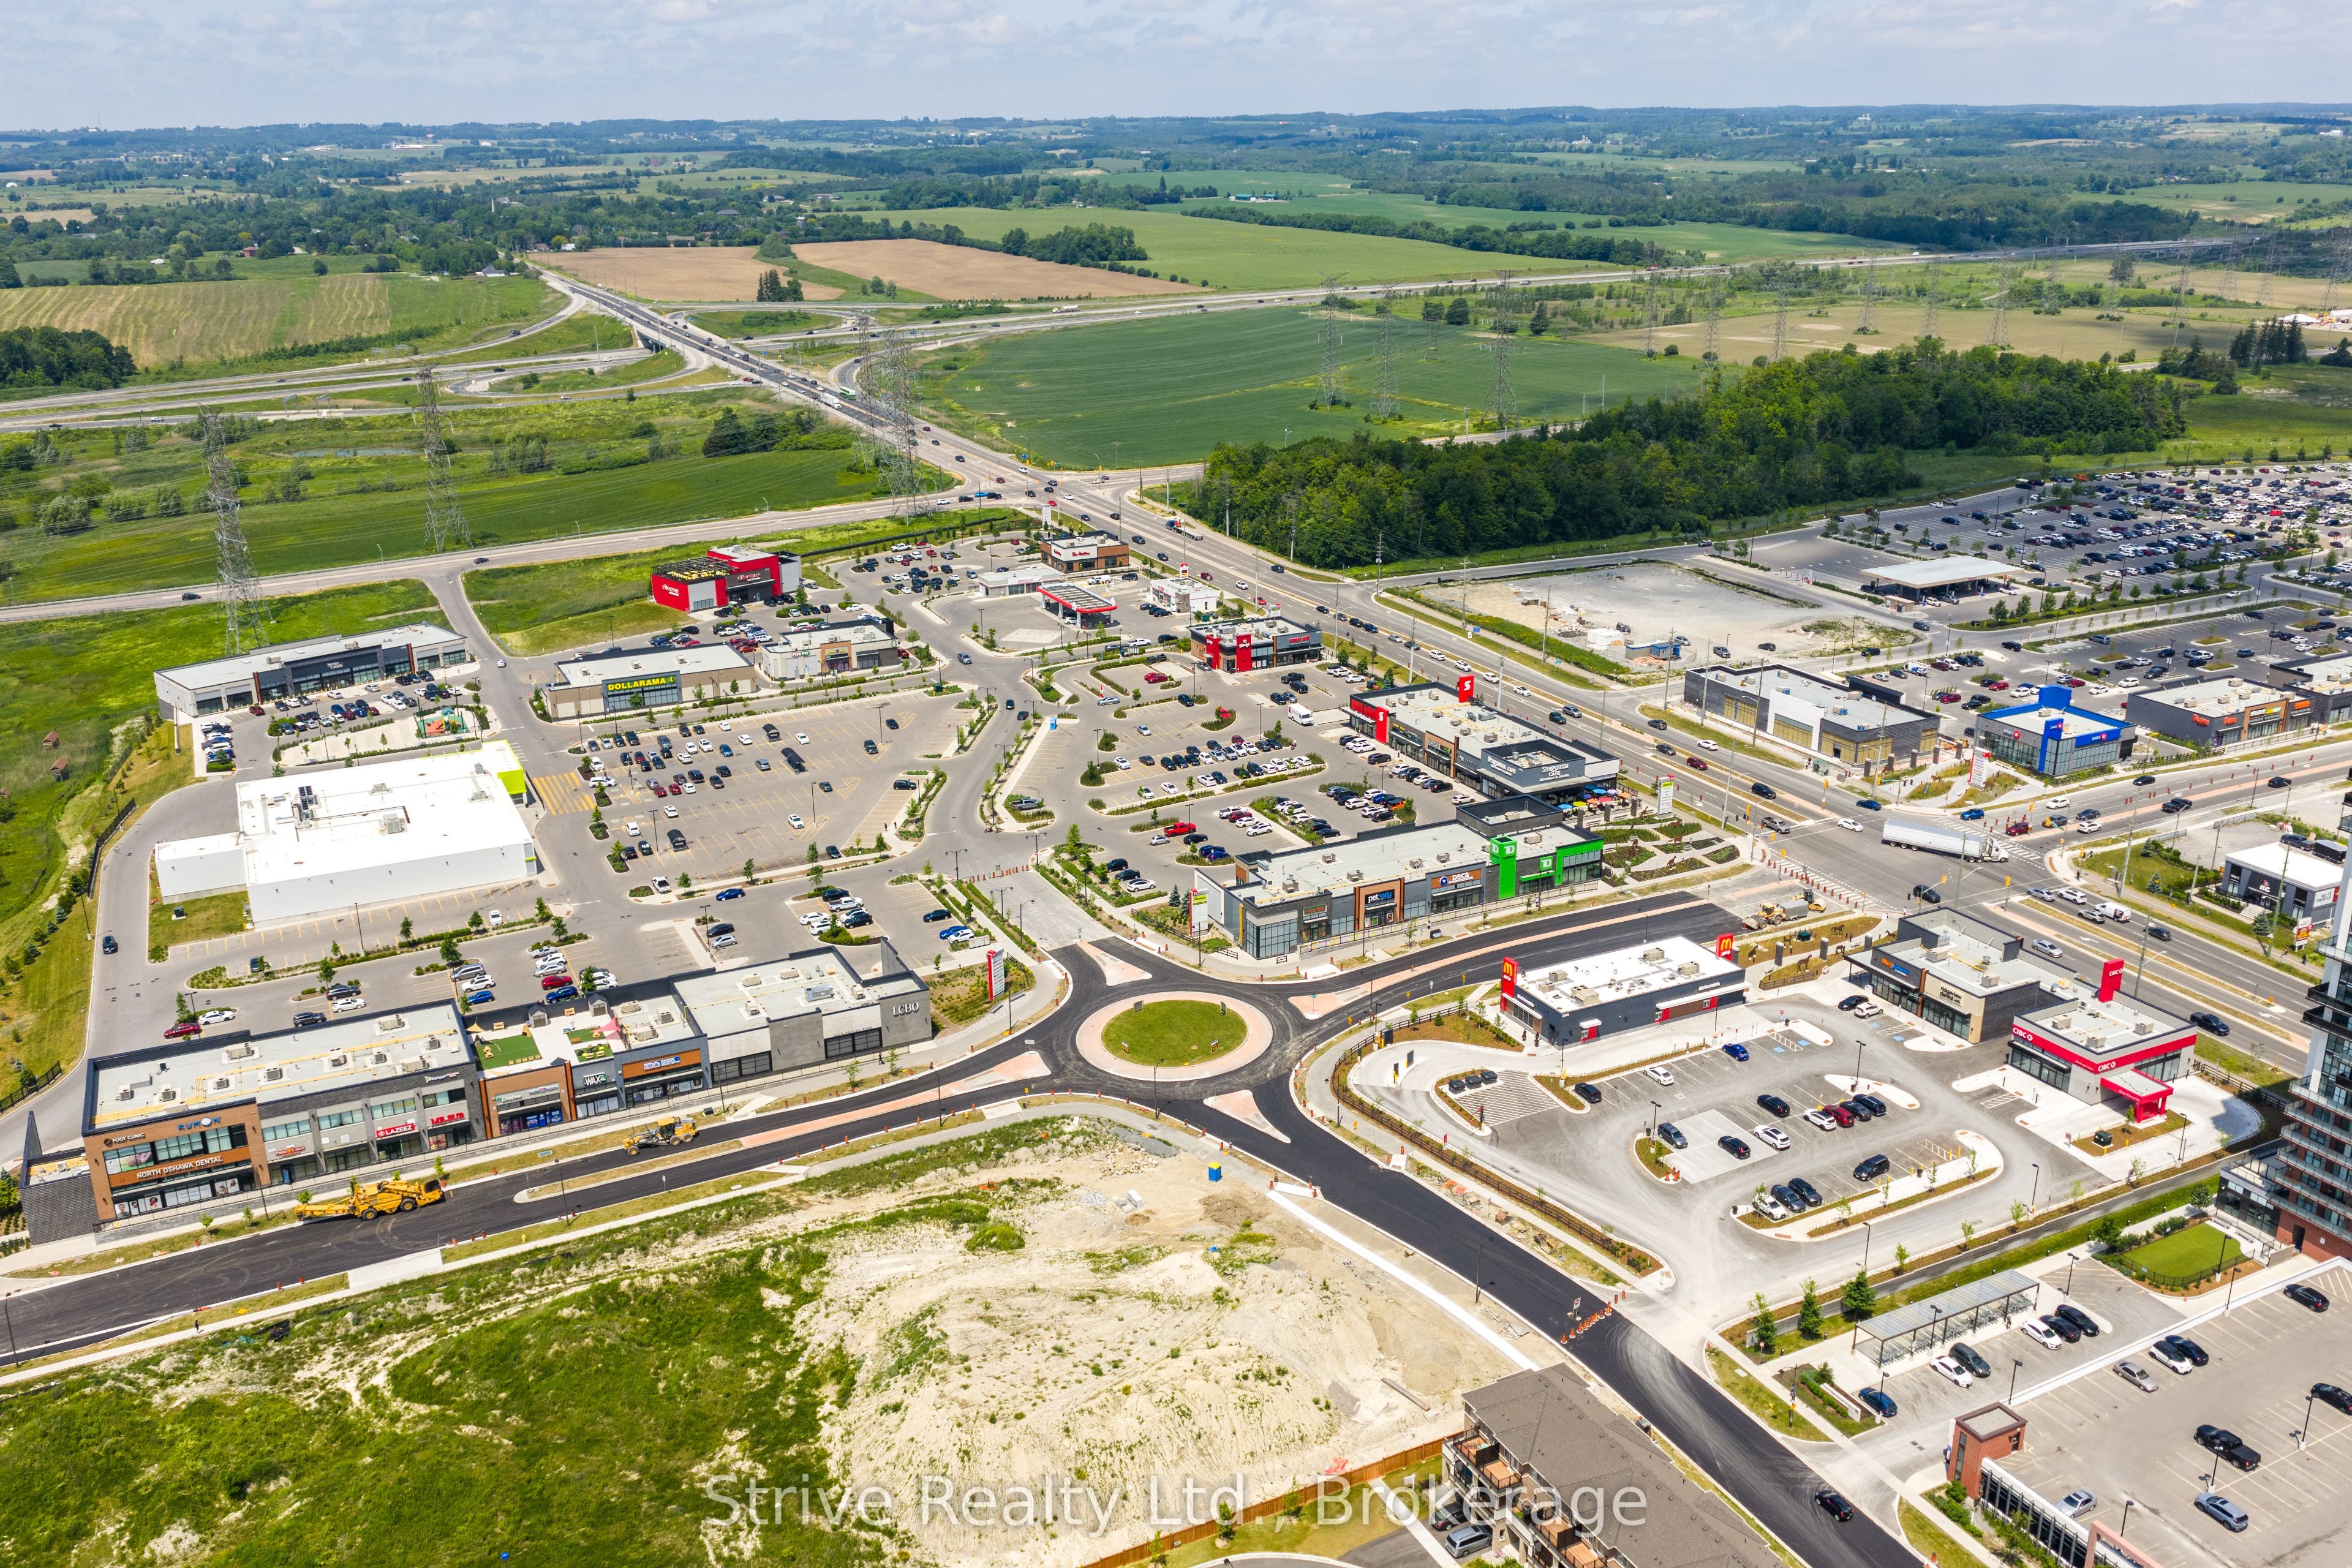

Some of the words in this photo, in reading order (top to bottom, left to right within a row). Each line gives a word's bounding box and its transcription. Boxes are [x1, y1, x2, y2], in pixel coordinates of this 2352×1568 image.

[608, 677, 666, 691] DOLLARAMA
[1491, 842, 1499, 854] TD
[1504, 845, 1515, 854] TD
[1541, 859, 1551, 868] TD
[1368, 894, 1379, 903] pet
[1379, 891, 1392, 900] valu
[1940, 986, 1962, 999] ridgeview
[892, 1001, 919, 1016] LCBO
[2013, 1027, 2027, 1039] CIBC
[2098, 1063, 2111, 1072] CIBC
[584, 1076, 601, 1086] WAX
[177, 1117, 221, 1131] KUMON
[385, 1124, 412, 1136] LAZEEZ
[137, 1169, 161, 1178] NORTH
[164, 1163, 194, 1174] OSHAWA
[195, 1156, 223, 1167] DENTAL
